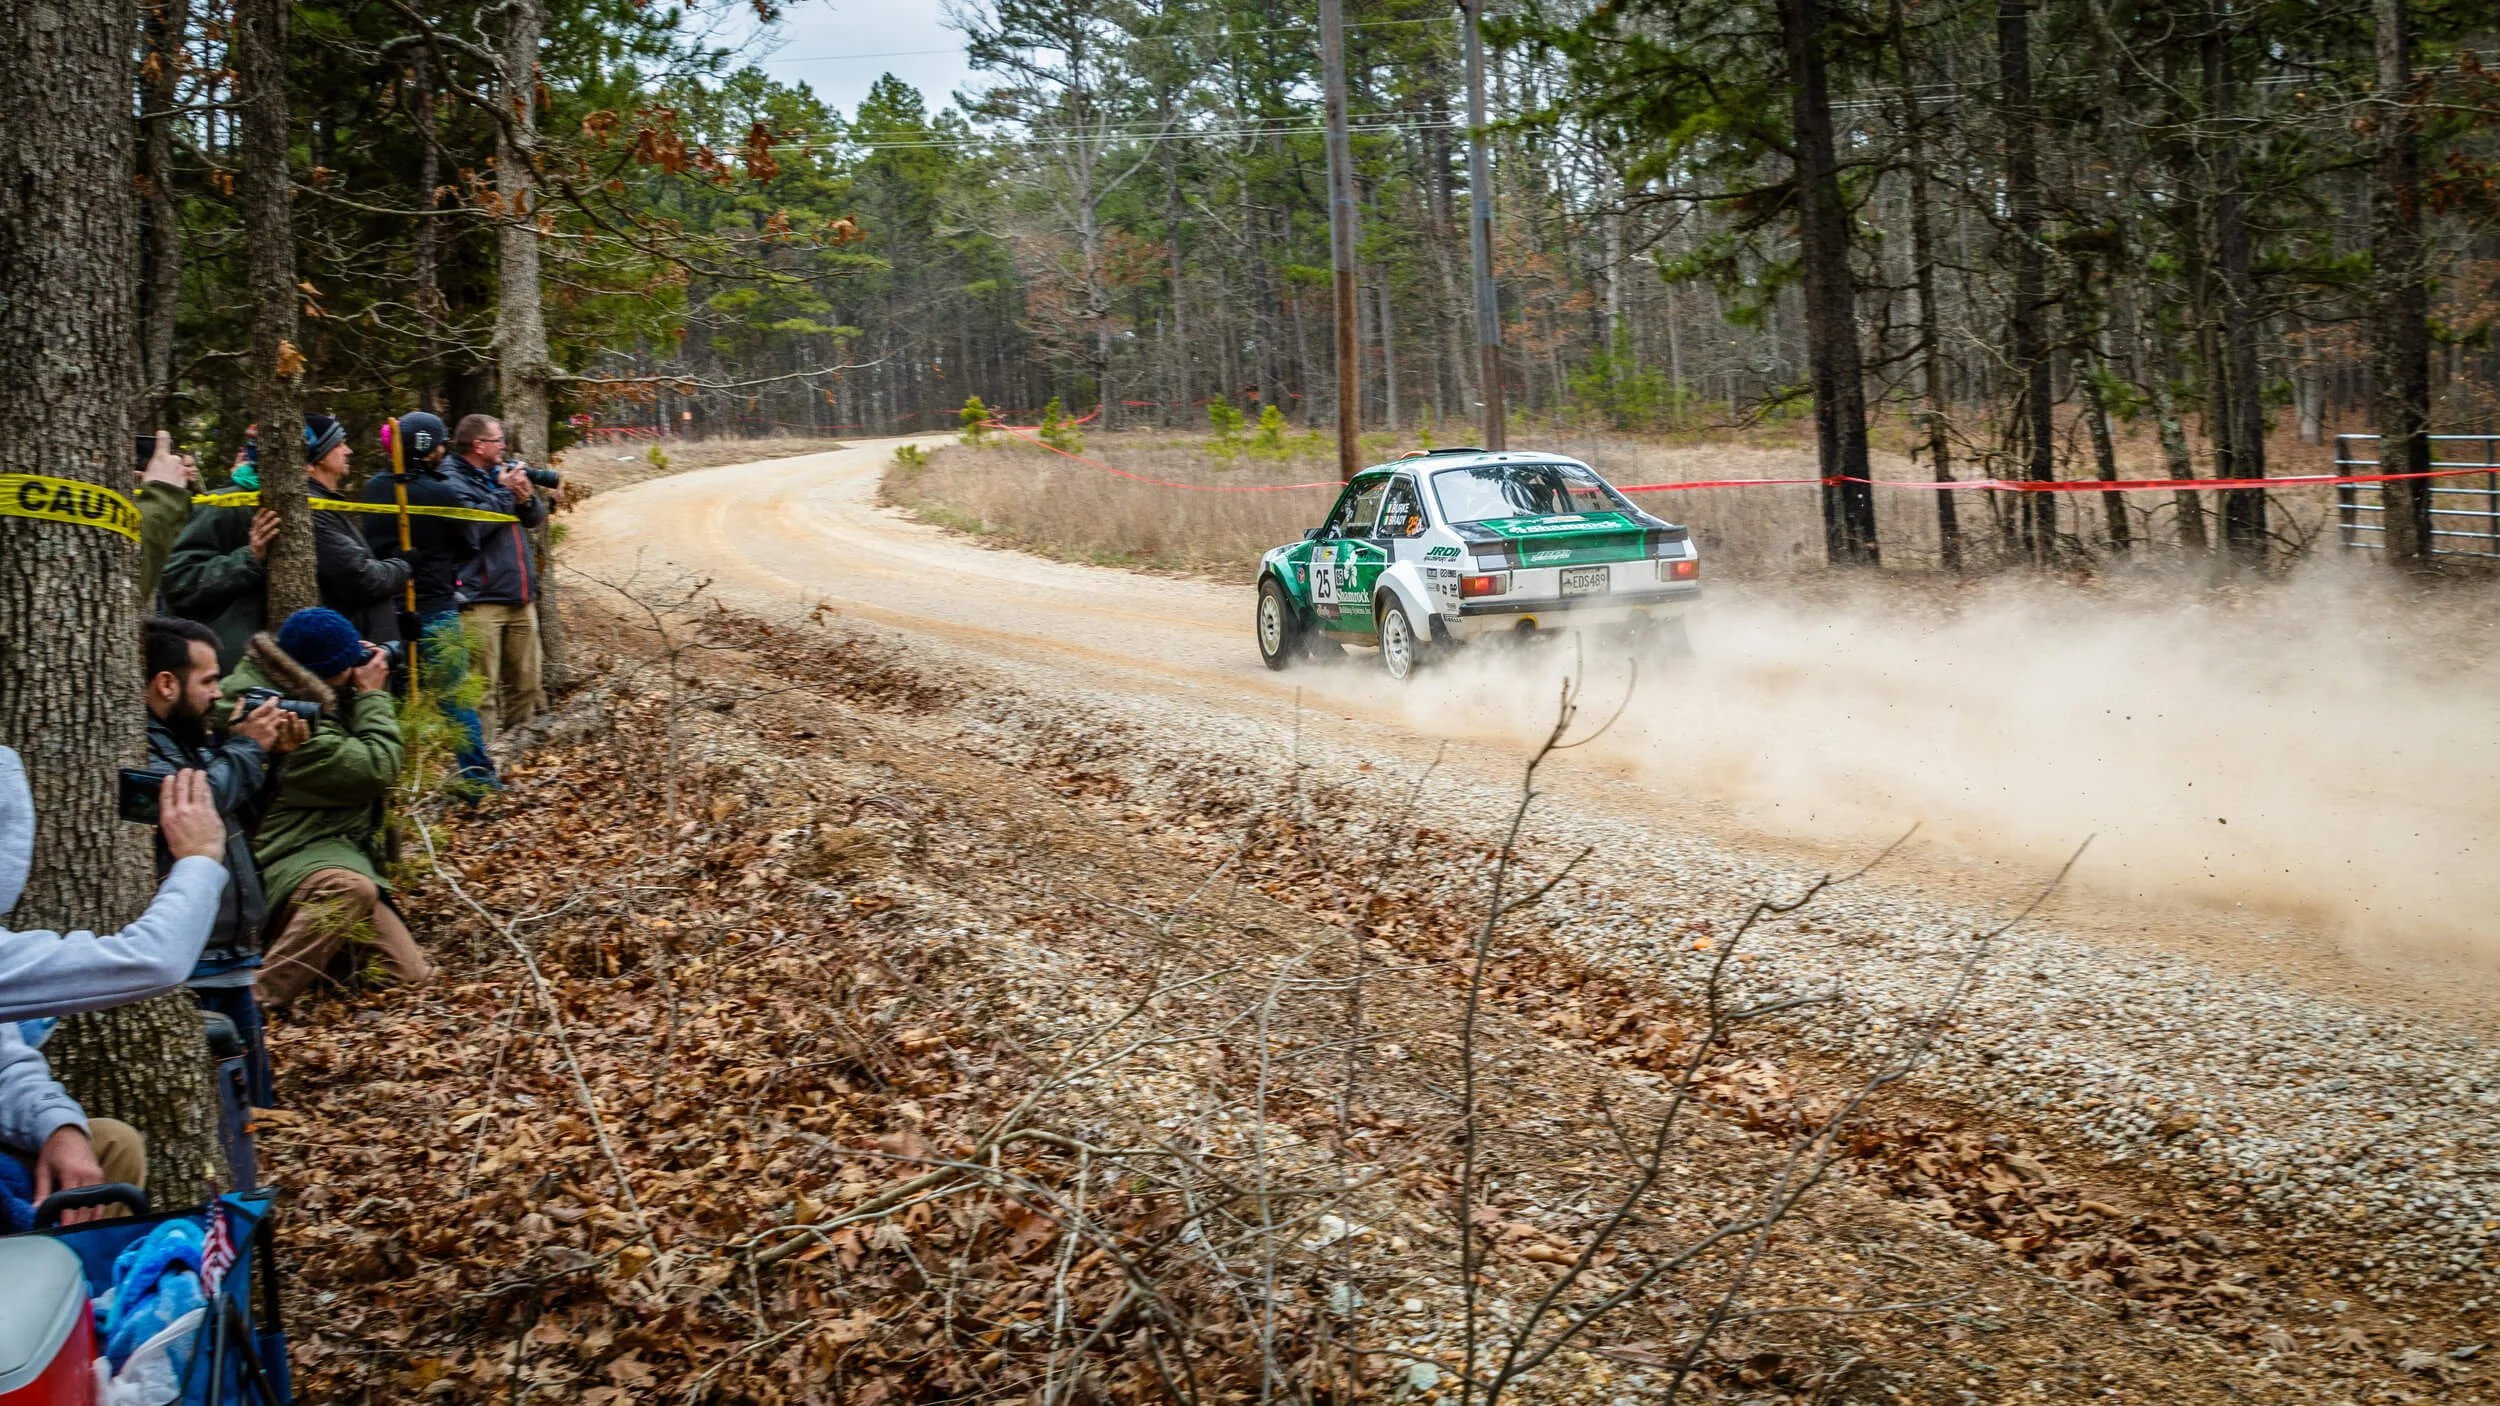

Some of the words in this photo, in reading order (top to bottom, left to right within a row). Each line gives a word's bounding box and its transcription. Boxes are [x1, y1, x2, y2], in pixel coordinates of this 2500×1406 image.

[1392, 503, 1410, 513] BURKE
[1316, 569, 1331, 598] 25
[1573, 574, 1606, 589] EDS489
[1336, 587, 1370, 603] Shamrock
